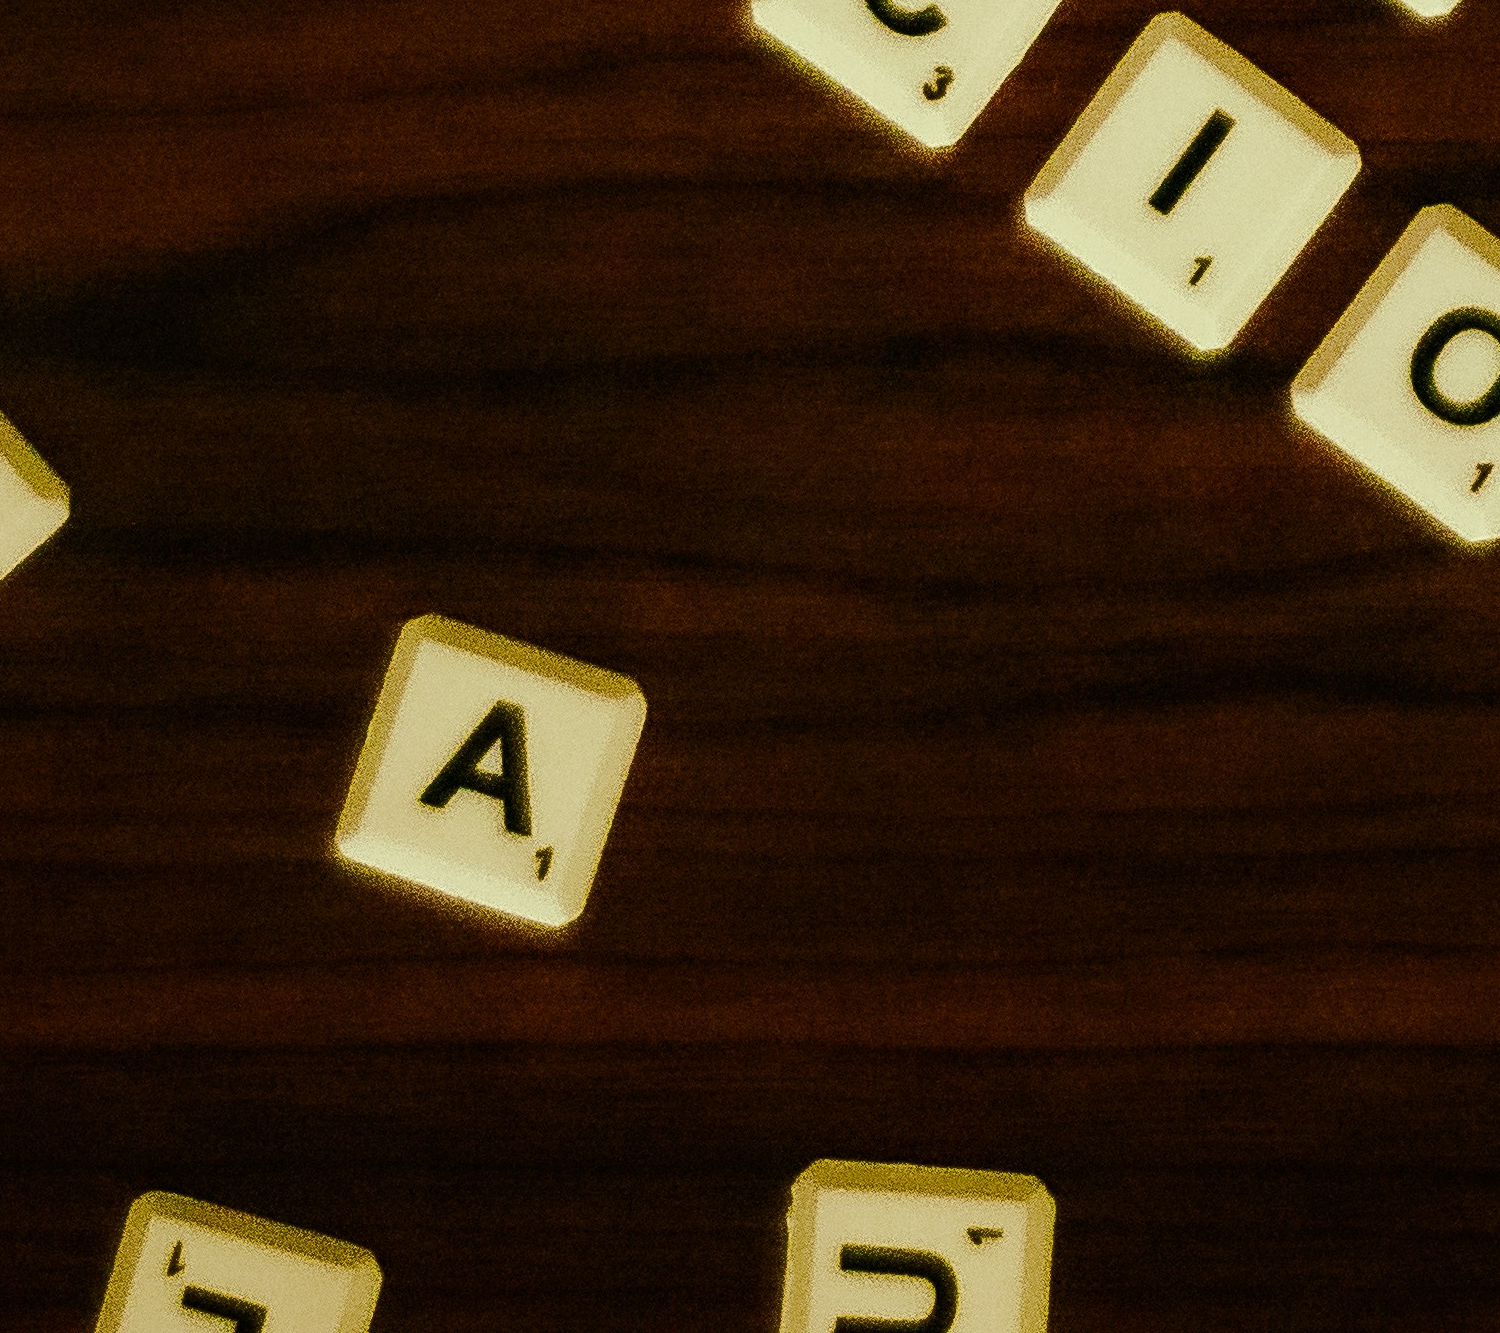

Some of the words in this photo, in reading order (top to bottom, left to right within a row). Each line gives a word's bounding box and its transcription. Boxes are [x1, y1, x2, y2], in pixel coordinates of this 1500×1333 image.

[923, 67, 952, 101] 3
[1189, 258, 1211, 286] 1
[1471, 464, 1493, 492] 1
[419, 702, 532, 838] A
[536, 848, 552, 880] 1
[967, 1229, 1001, 1245] 1
[167, 1243, 183, 1276] 1
